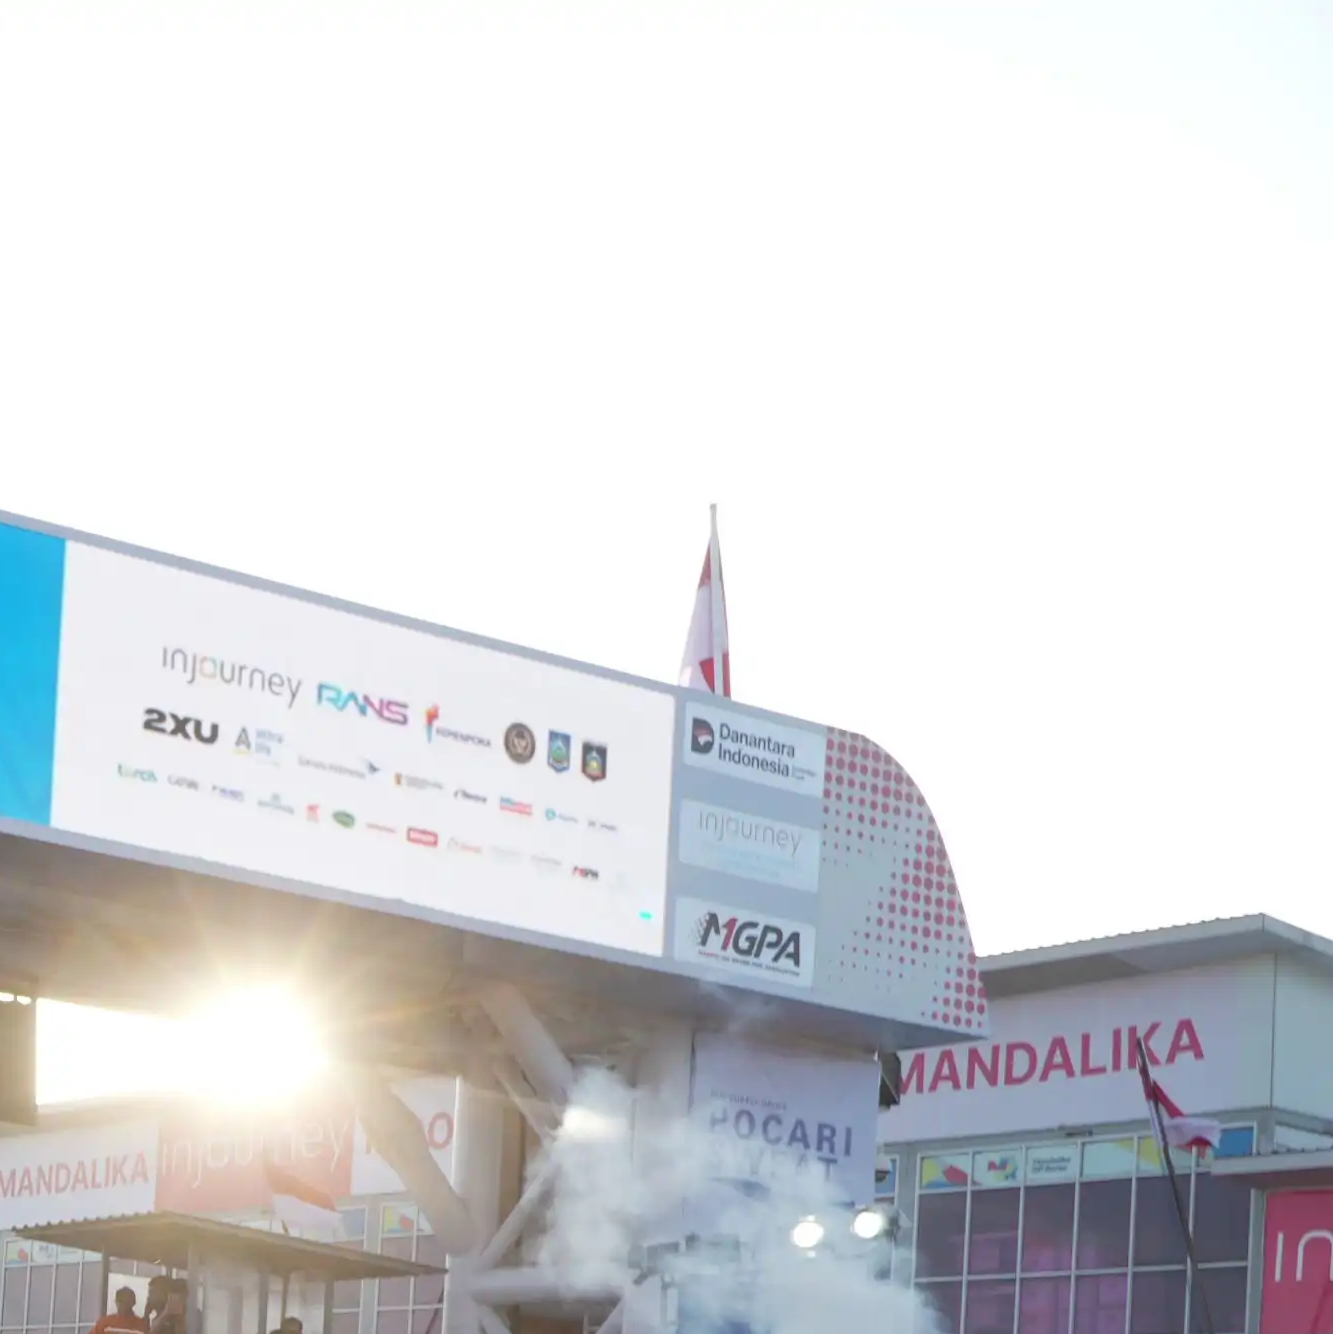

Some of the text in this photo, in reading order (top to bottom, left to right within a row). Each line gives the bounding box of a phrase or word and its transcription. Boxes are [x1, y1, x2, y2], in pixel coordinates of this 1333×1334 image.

[162, 646, 303, 709] injourney
[316, 680, 410, 726] RANS
[143, 708, 219, 745] 2XU
[719, 722, 796, 759] Danantara
[717, 742, 790, 778] Indonesia
[698, 810, 803, 856] injourney
